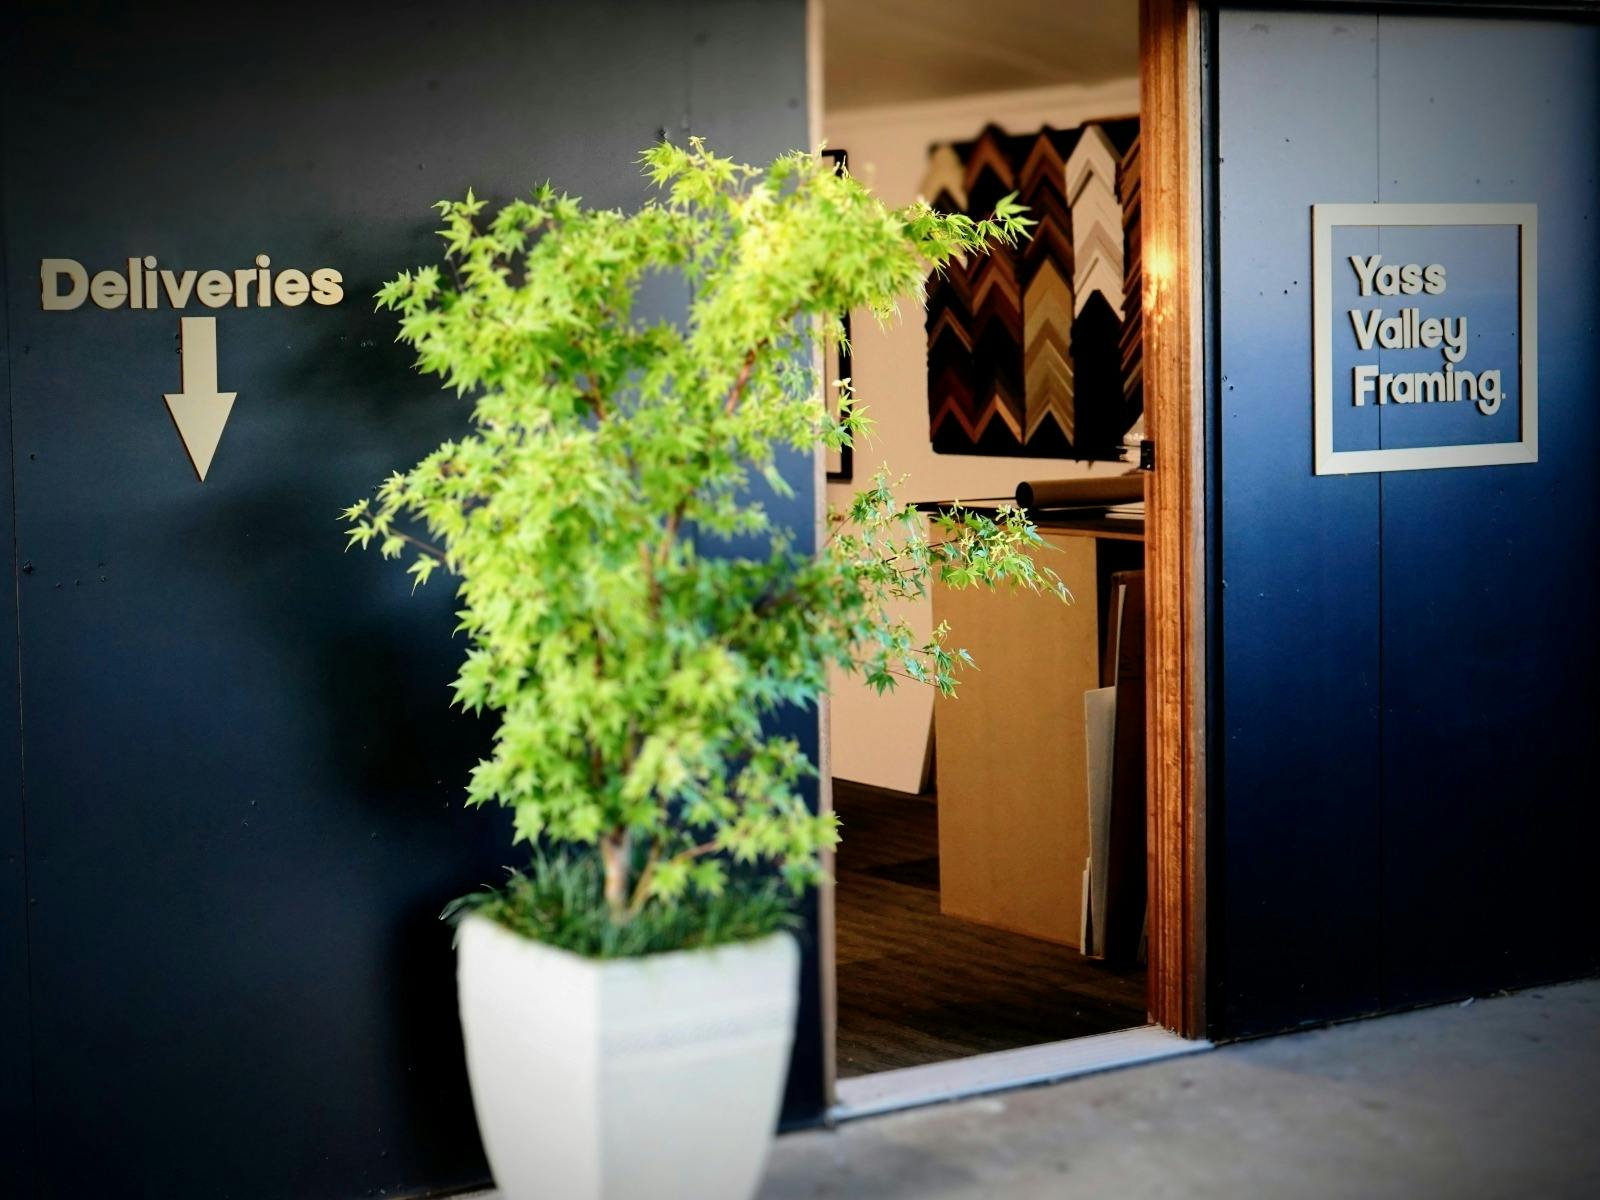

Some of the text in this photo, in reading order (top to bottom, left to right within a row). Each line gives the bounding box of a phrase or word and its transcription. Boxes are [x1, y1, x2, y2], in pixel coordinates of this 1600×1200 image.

[41, 254, 344, 311] Deliveries
[1349, 254, 1446, 296] Yass
[1349, 308, 1467, 363] Valley
